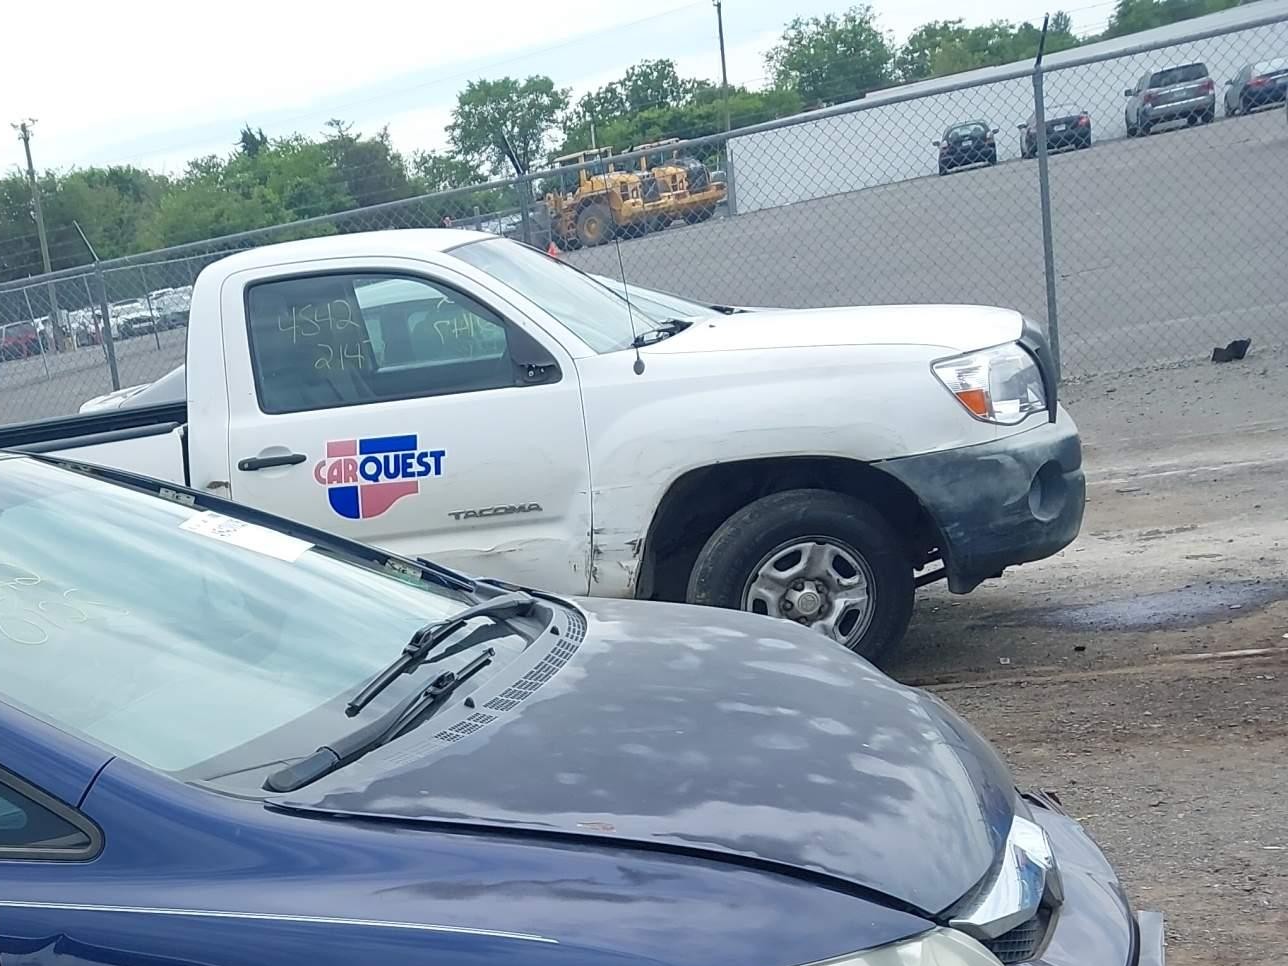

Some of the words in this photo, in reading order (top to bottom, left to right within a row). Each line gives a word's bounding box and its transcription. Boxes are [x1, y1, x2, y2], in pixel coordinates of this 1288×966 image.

[277, 299, 360, 345] 4542
[314, 339, 373, 371] 214
[314, 450, 446, 485] CARQUEST
[448, 502, 543, 521] TACOMA
